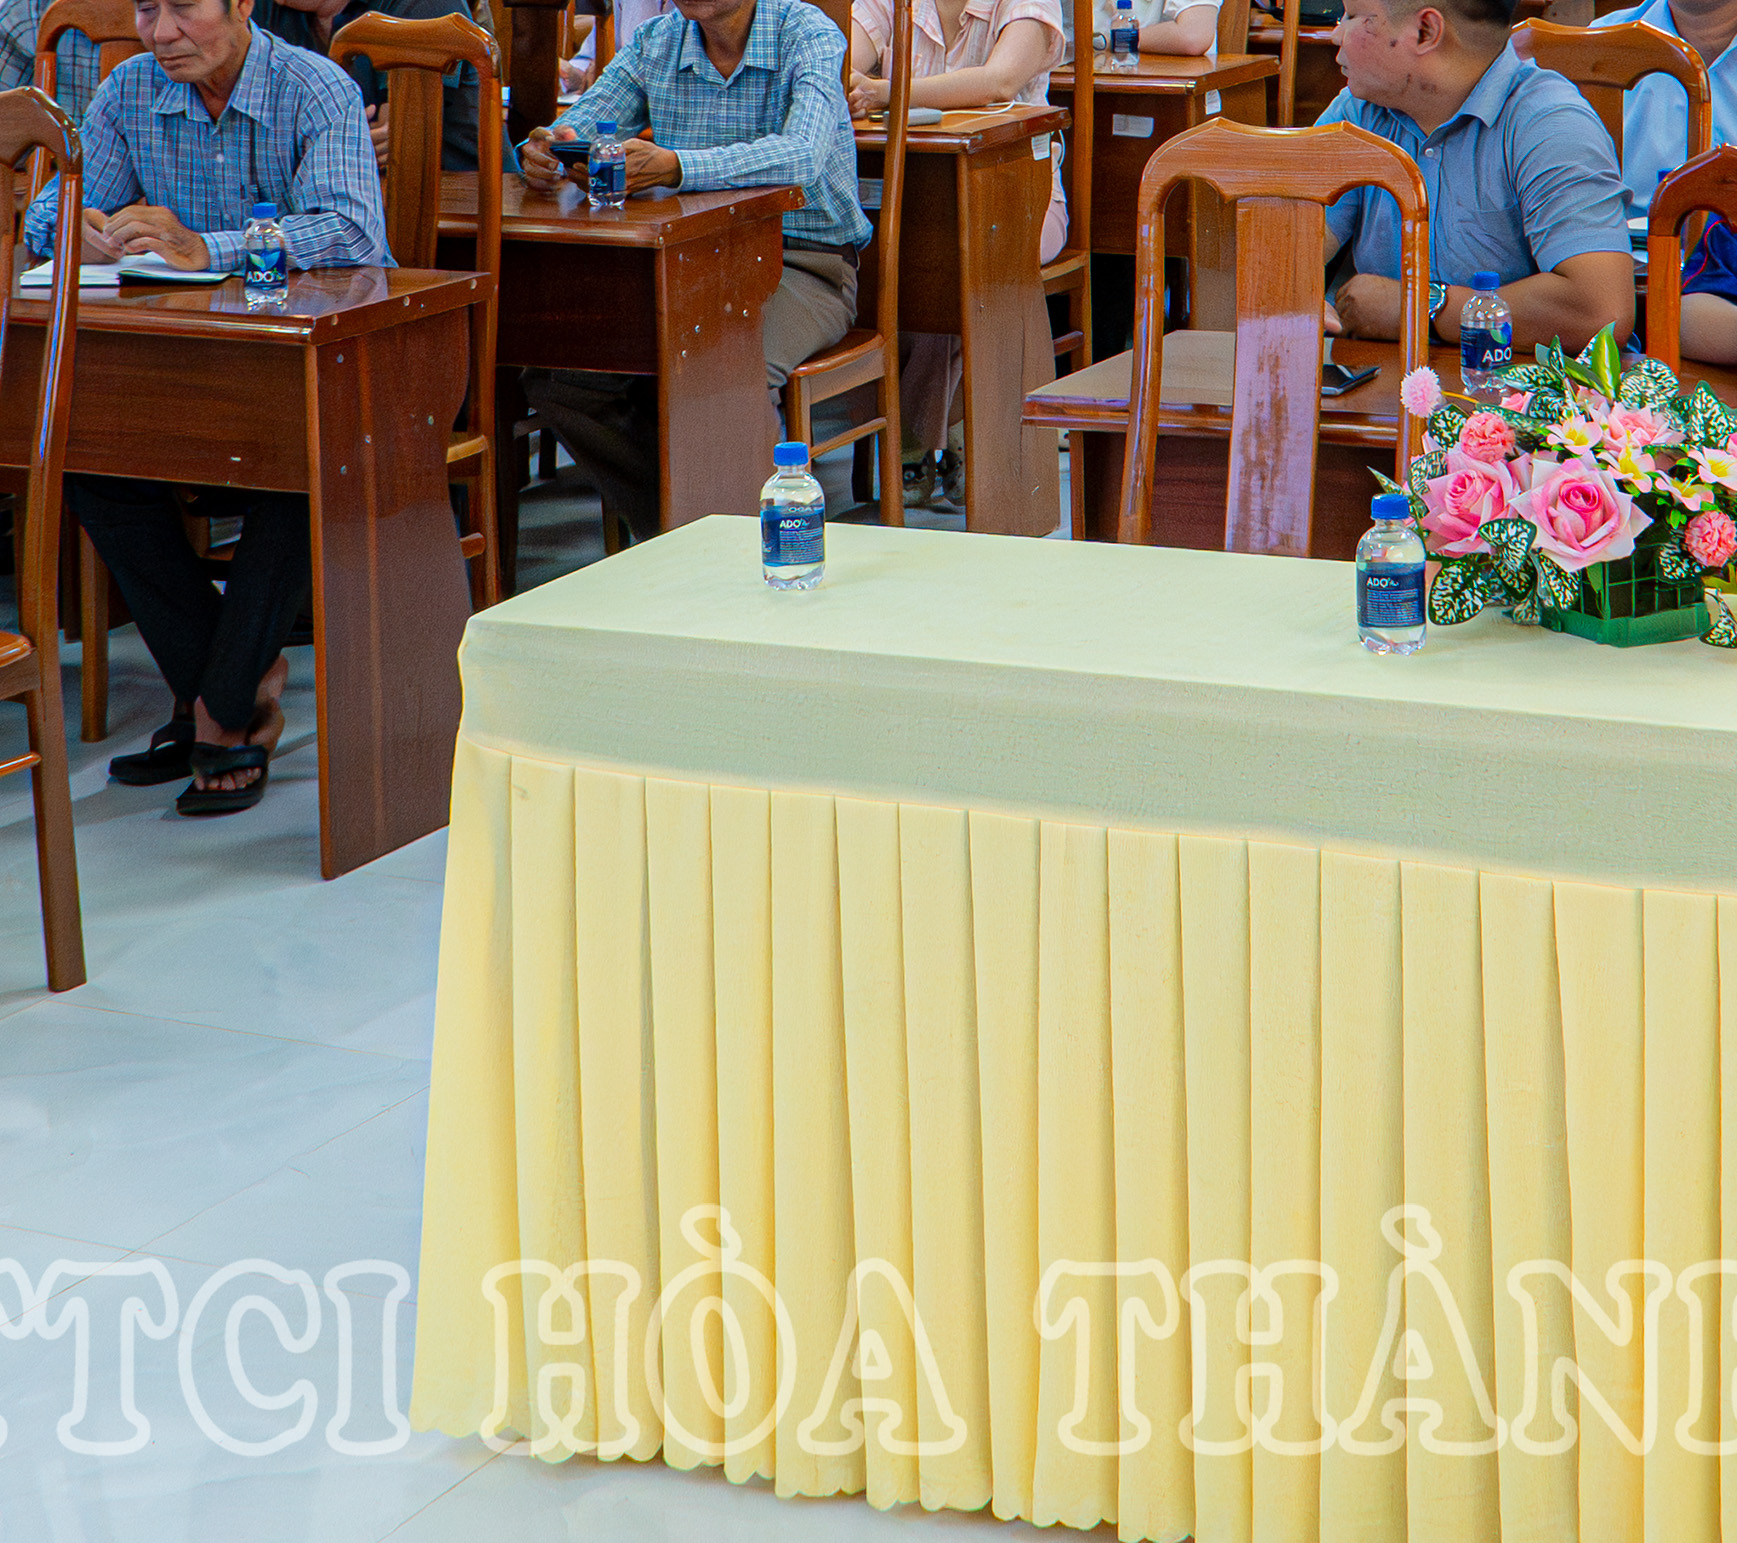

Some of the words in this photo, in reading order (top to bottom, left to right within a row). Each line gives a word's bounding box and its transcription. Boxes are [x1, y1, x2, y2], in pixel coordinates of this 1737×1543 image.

[246, 270, 274, 283] ADO
[1481, 346, 1513, 363] ADO
[779, 518, 802, 529] ADO
[1366, 576, 1390, 588] ADO
